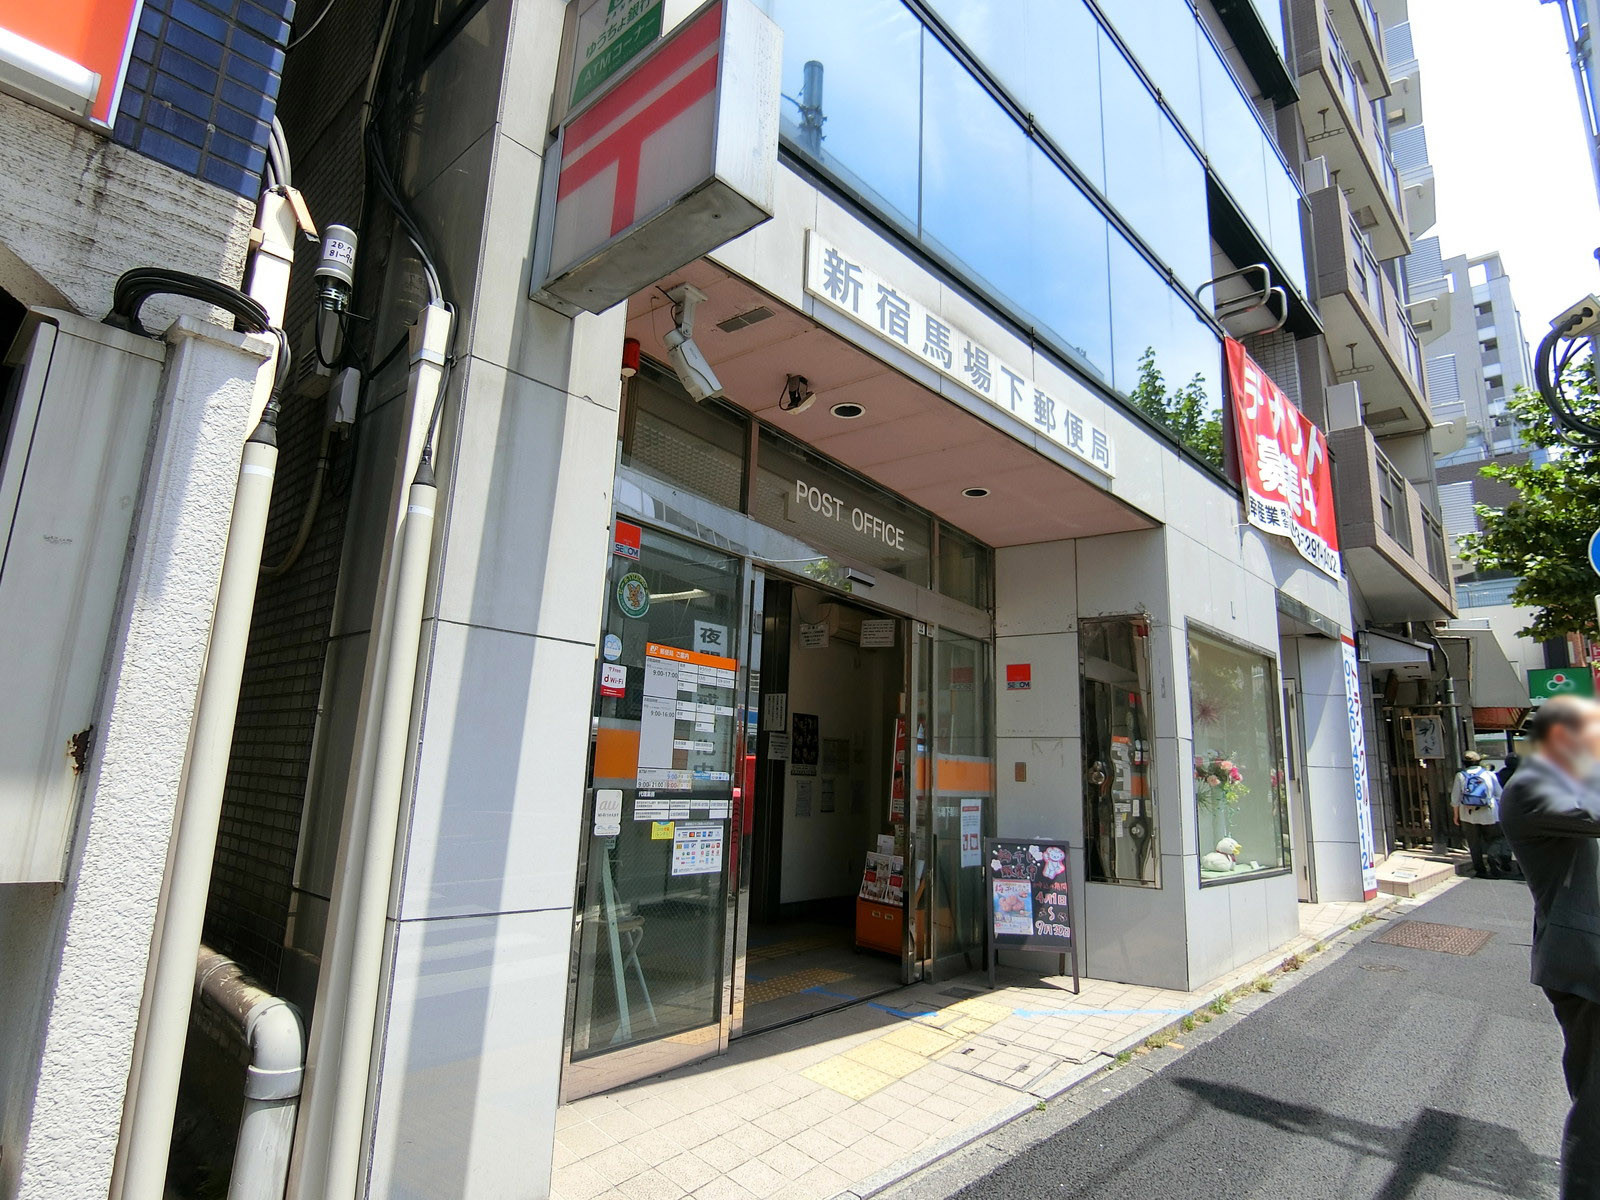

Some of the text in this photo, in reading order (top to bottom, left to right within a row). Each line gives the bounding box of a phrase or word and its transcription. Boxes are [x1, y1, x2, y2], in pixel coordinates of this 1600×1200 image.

[584, 17, 657, 84] ATMコーナー
[823, 247, 1110, 469] 新宿馬場下郵便局
[1244, 366, 1323, 476] テナント
[1256, 433, 1318, 528] 募集中
[796, 479, 905, 552] POST OFFICE
[615, 543, 639, 558] SECOM
[610, 677, 624, 685] Wi-Fi
[1344, 660, 1369, 870] 0120-488-112
[599, 799, 619, 811] au
[1035, 920, 1071, 938] 9月30日
[1036, 891, 1067, 906] 4月1日
